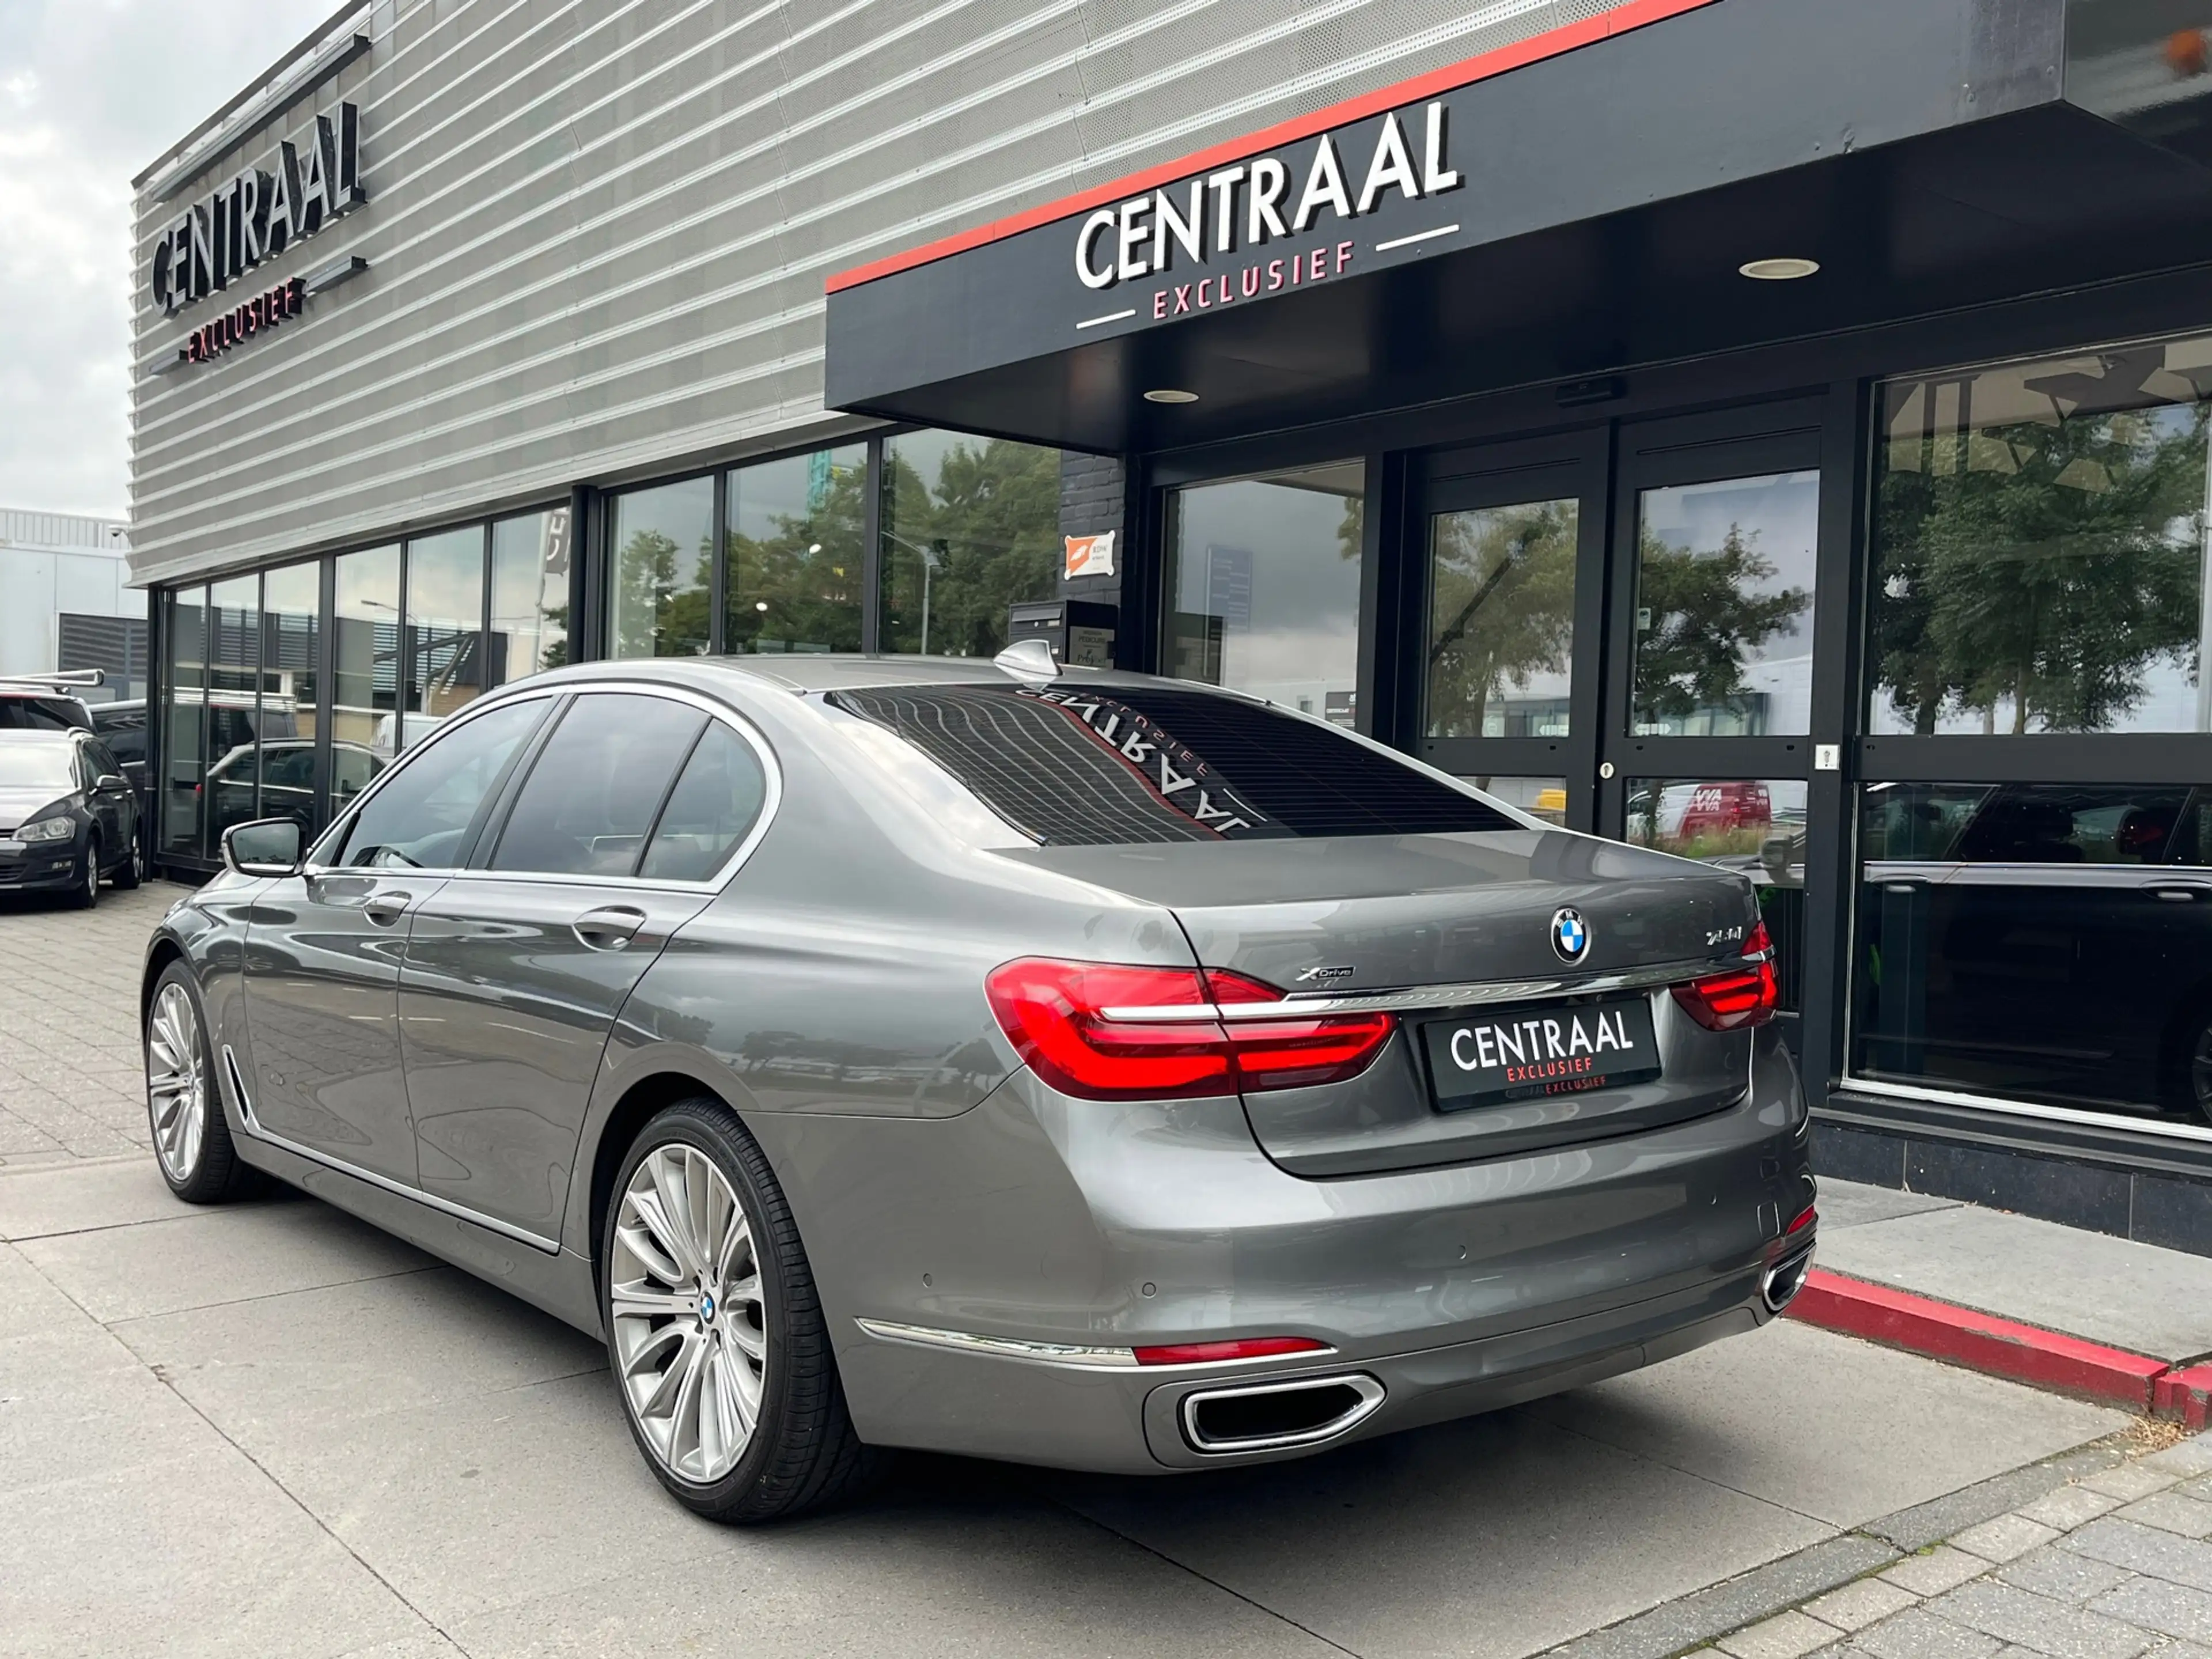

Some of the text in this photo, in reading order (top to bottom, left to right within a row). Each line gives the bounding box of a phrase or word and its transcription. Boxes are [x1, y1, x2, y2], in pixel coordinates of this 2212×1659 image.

[151, 101, 365, 319] CENTRAAL
[1075, 101, 1459, 288] CENTRAAL
[1153, 241, 1354, 319] EXCLUSIEF
[188, 277, 300, 364] EXCLUSIEF
[1556, 910, 1583, 928] BMW
[1450, 1010, 1634, 1071] CENTRAAL
[1507, 1057, 1592, 1082] EXCLUSIEF
[1546, 1075, 1607, 1094] EXCLUSIEF
